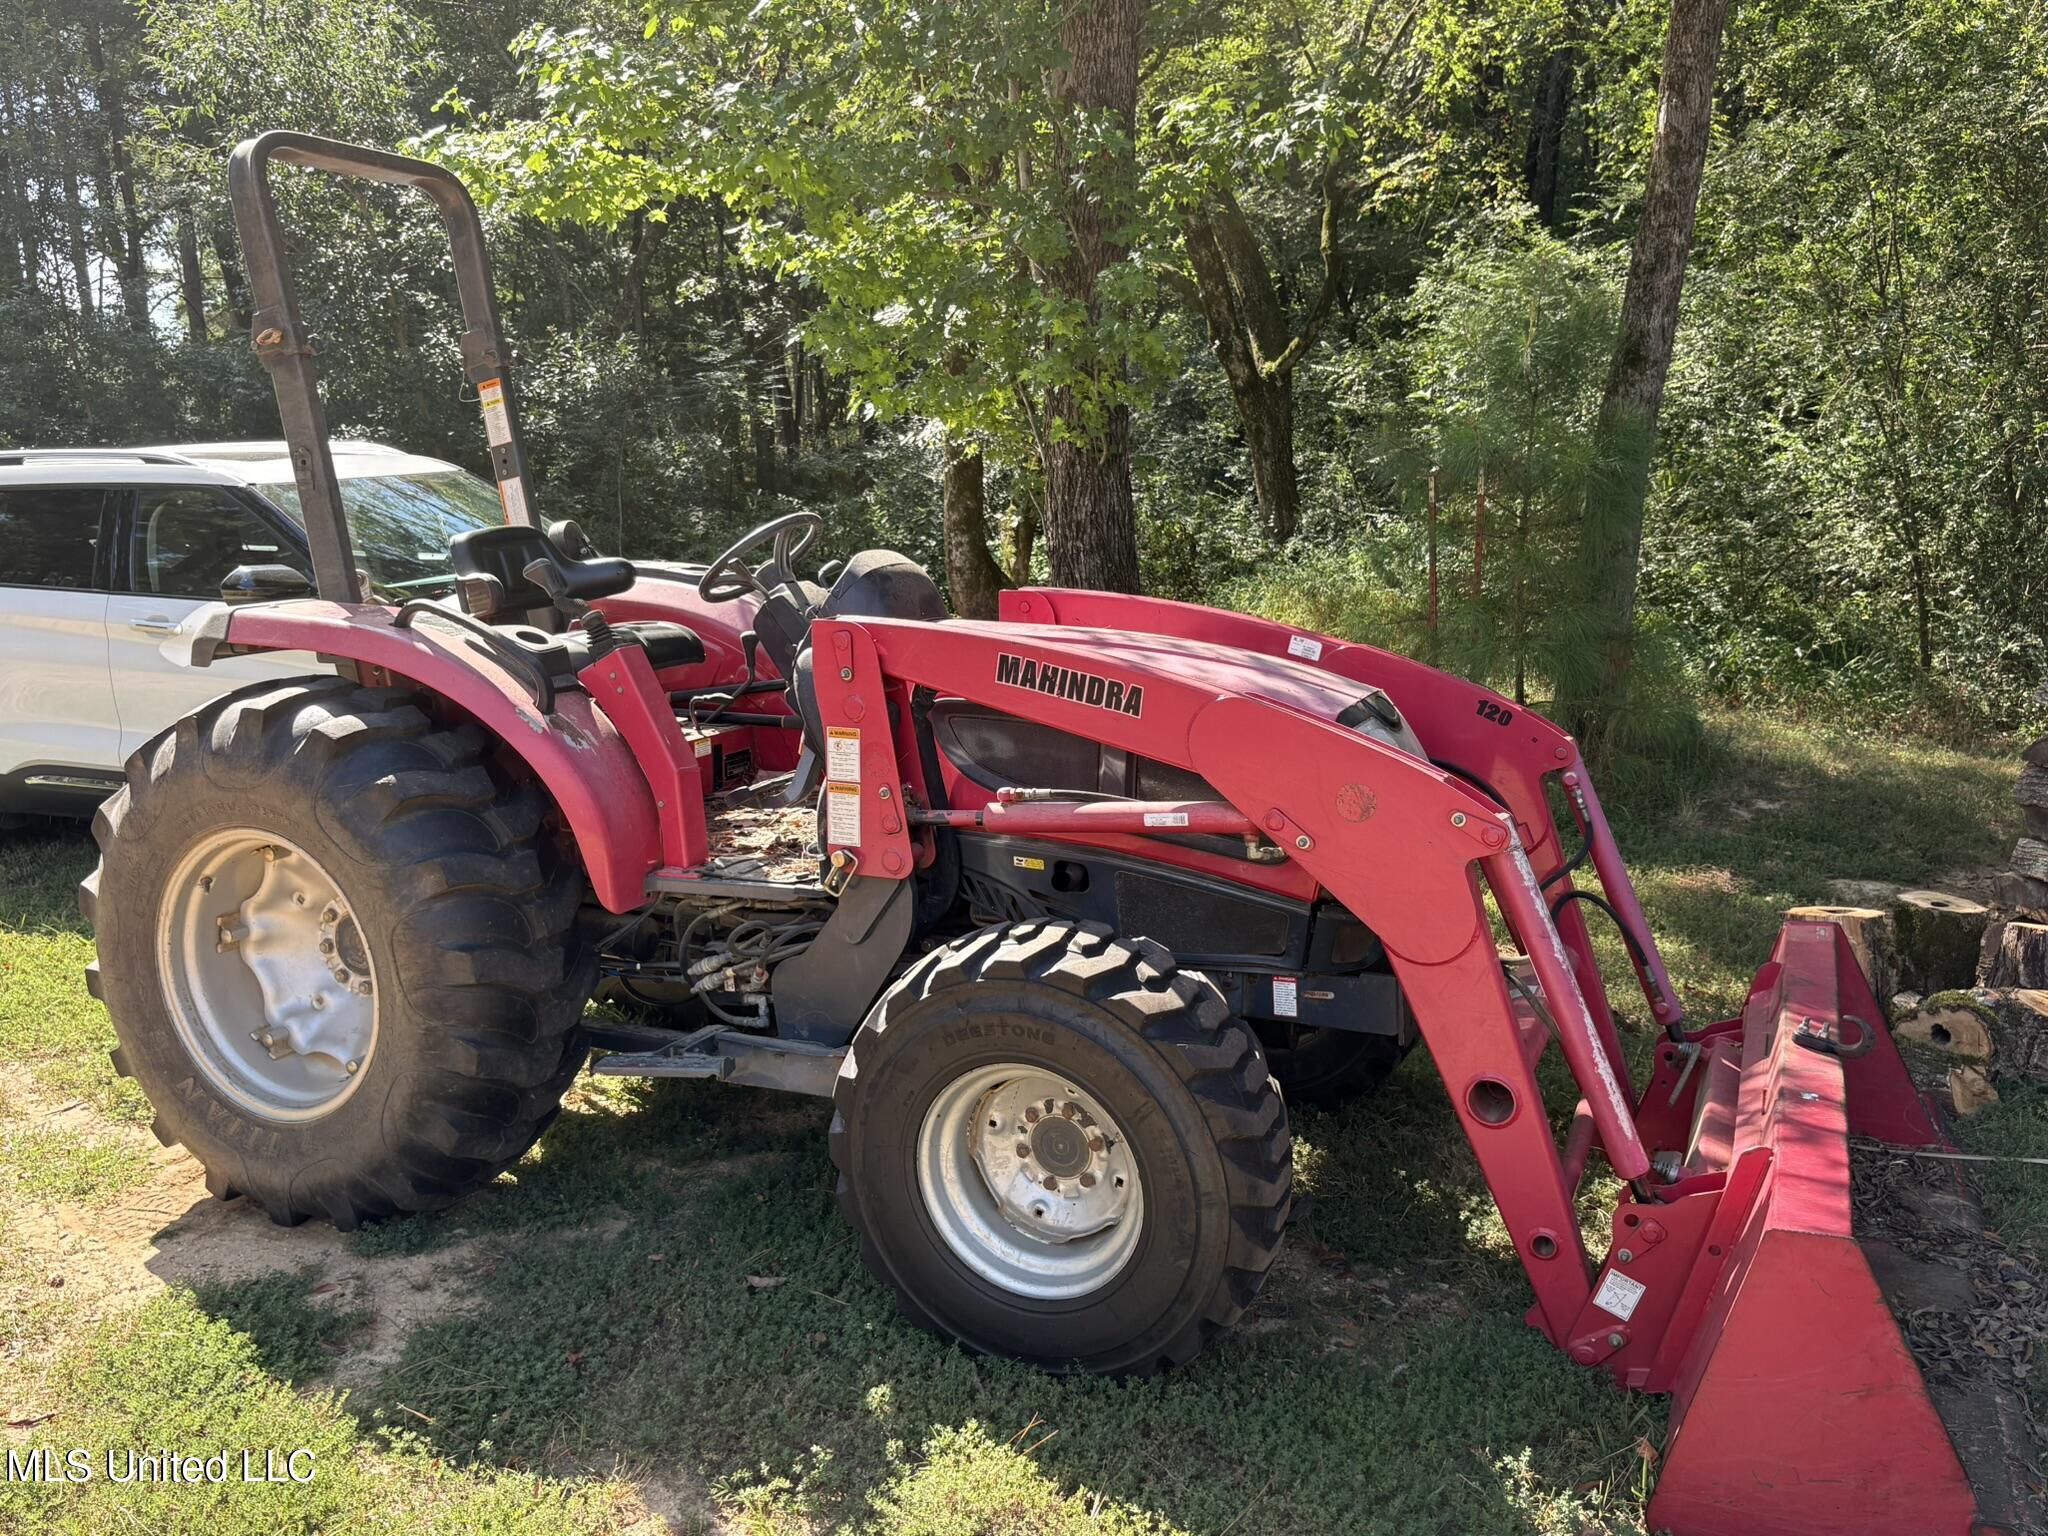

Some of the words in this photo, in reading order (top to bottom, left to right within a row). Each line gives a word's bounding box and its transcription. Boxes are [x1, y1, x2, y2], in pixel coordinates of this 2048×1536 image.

[996, 653, 1144, 718] MAHINDRA
[1476, 699, 1513, 727] 120
[1611, 1271, 1643, 1290] IMPORTANT
